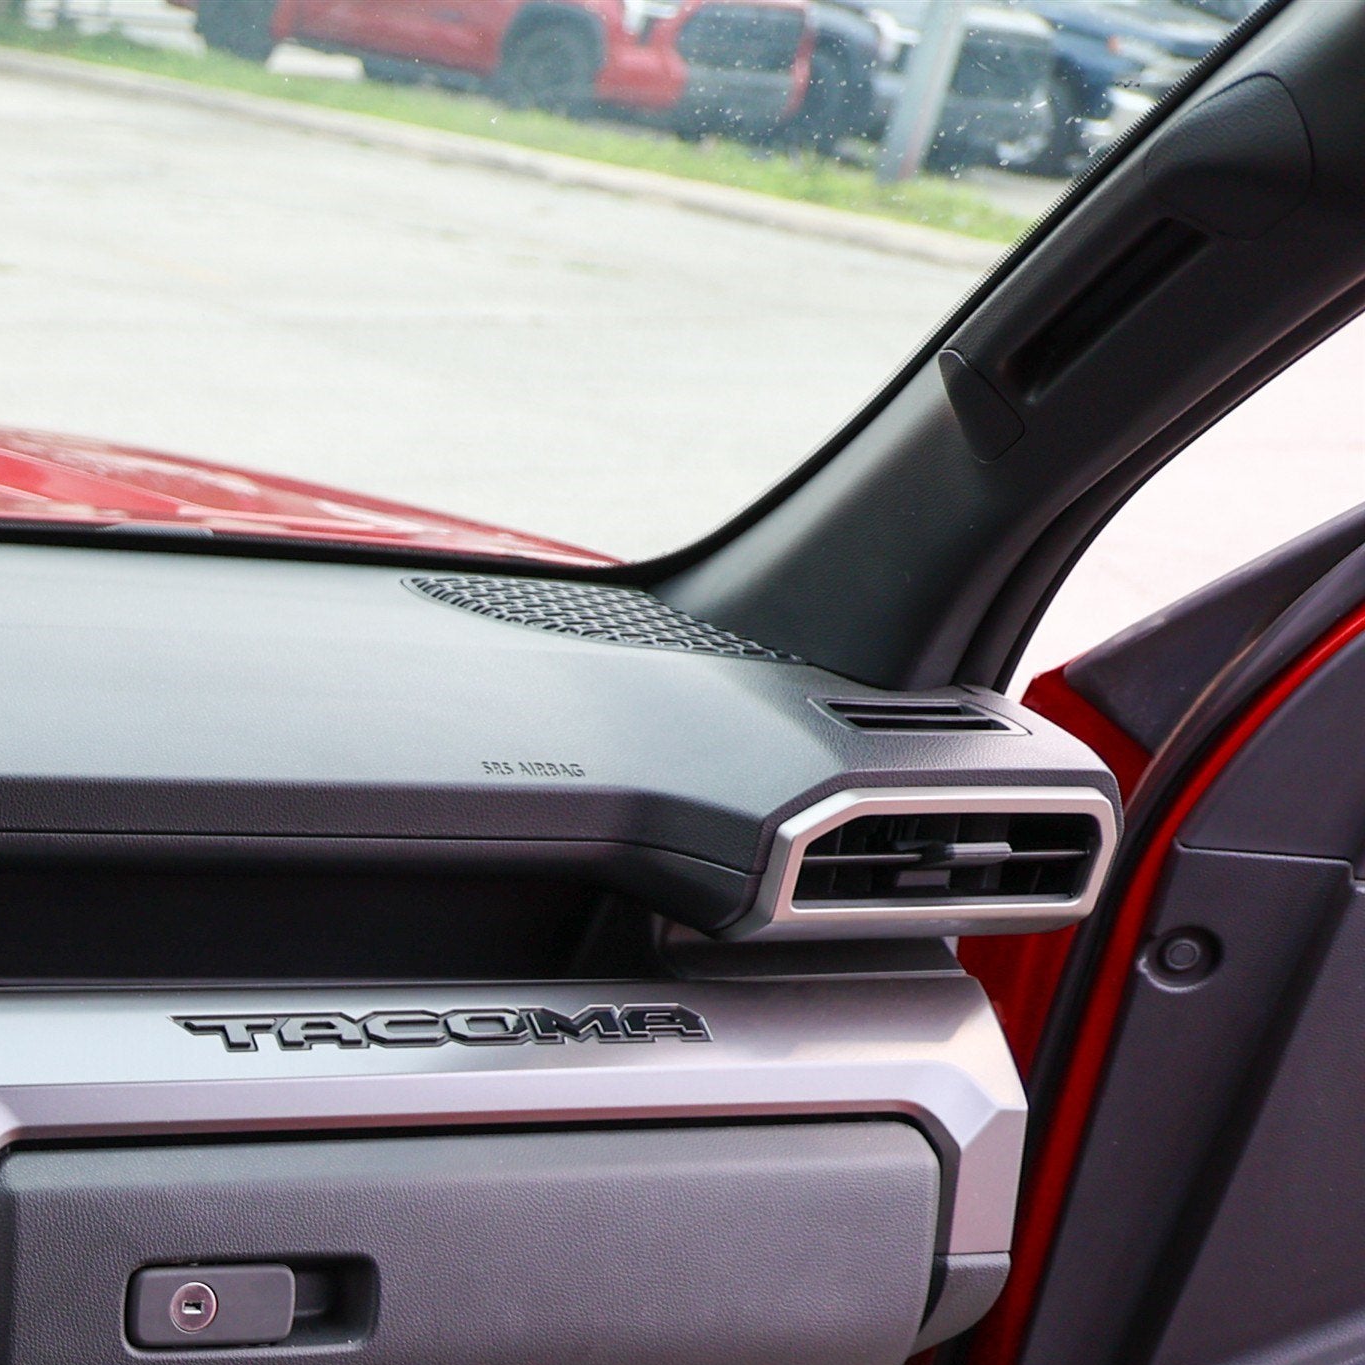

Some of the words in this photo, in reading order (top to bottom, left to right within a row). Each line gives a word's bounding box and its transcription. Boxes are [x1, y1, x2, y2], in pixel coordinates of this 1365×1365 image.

[482, 761, 514, 778] SRS
[519, 761, 586, 779] AIRBAG
[167, 1002, 714, 1053] TACOMA
